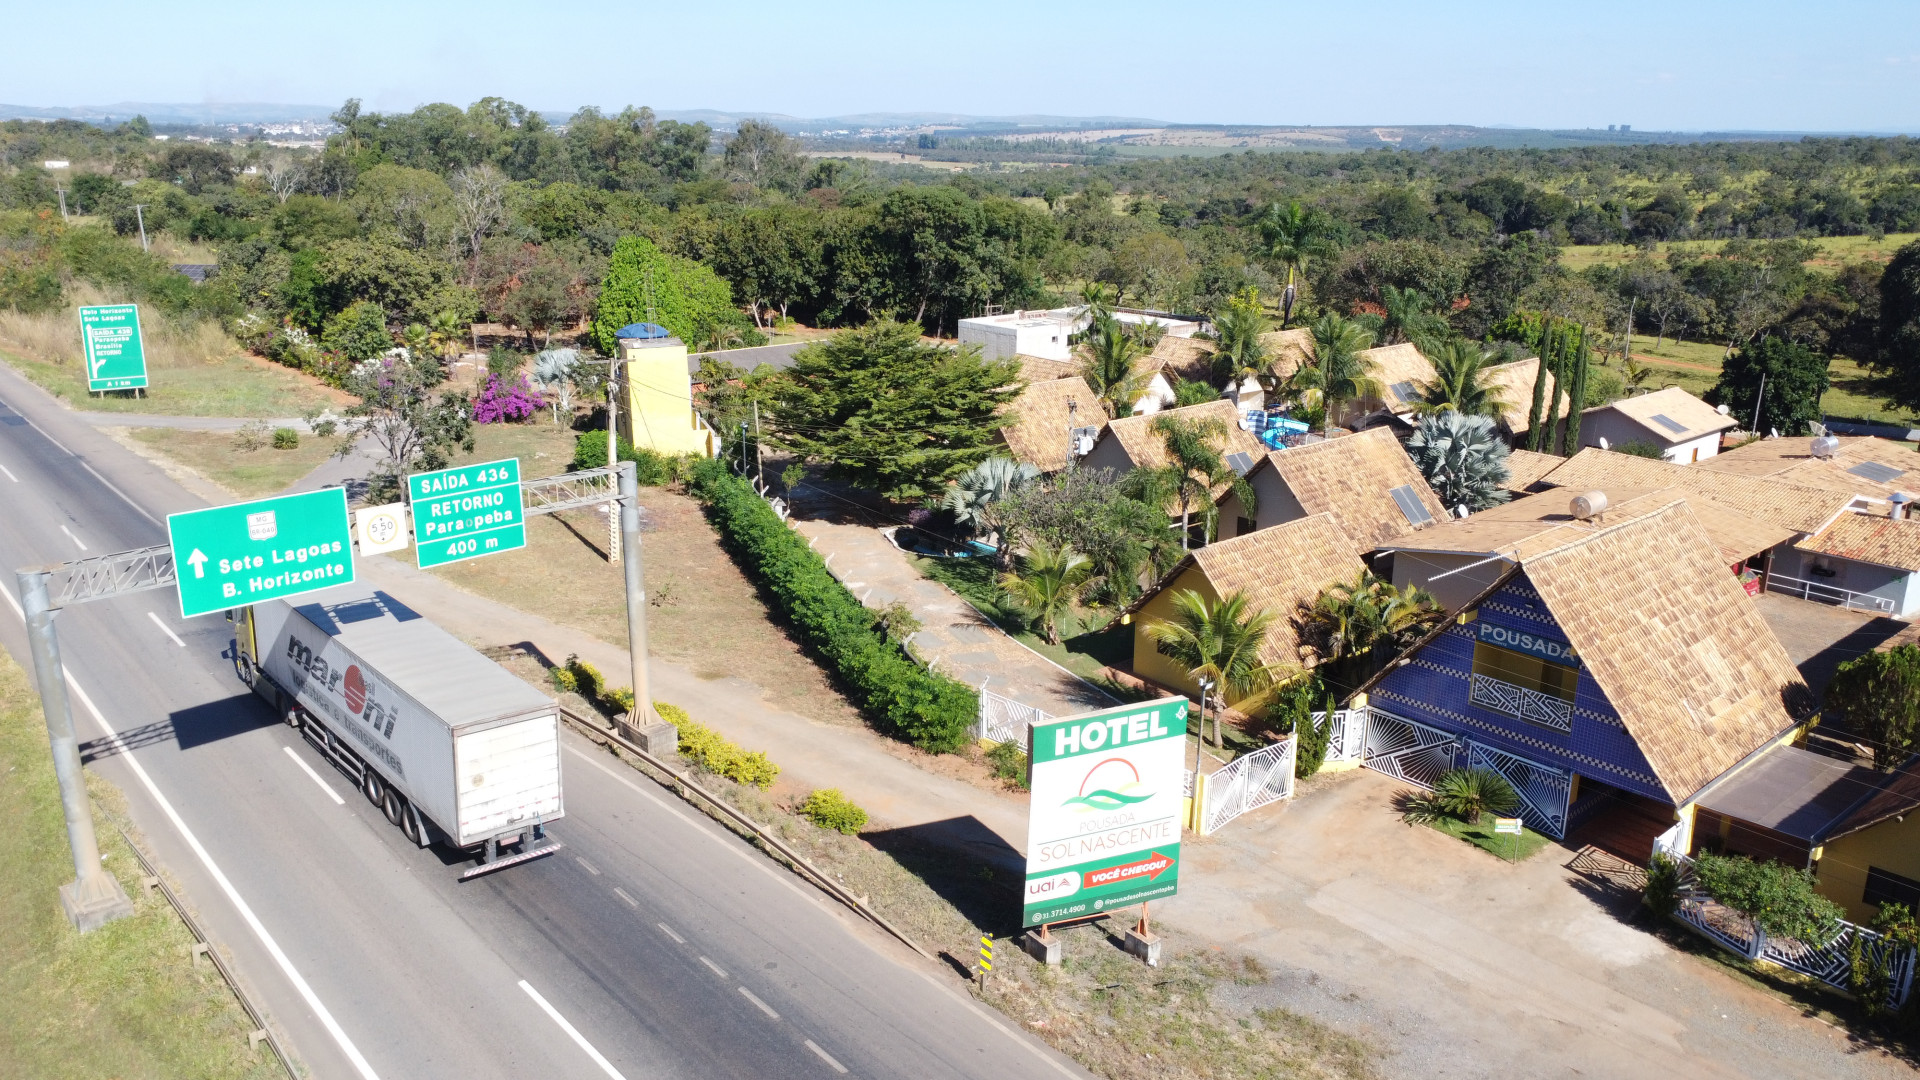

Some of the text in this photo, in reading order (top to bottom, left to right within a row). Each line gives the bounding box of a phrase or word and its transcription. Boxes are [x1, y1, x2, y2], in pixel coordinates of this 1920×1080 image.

[421, 466, 509, 493] SAÍDA 436
[430, 492, 504, 517] RETORNO
[425, 508, 513, 536] Paraopeba
[219, 540, 342, 574] Sete Lagoas
[447, 536, 499, 557] 400 m
[223, 562, 344, 599] B. Horizonte
[1480, 623, 1576, 662] POUSADA
[344, 717, 404, 775] transportes
[1054, 711, 1168, 757] HOTEL
[1079, 812, 1136, 833] POUSADA
[1040, 821, 1171, 863] SOL NASCENTE
[1092, 859, 1167, 883] VOCÊ CHEGOU!
[1030, 878, 1055, 895] uai
[1042, 904, 1086, 920] 31.3714.4900
